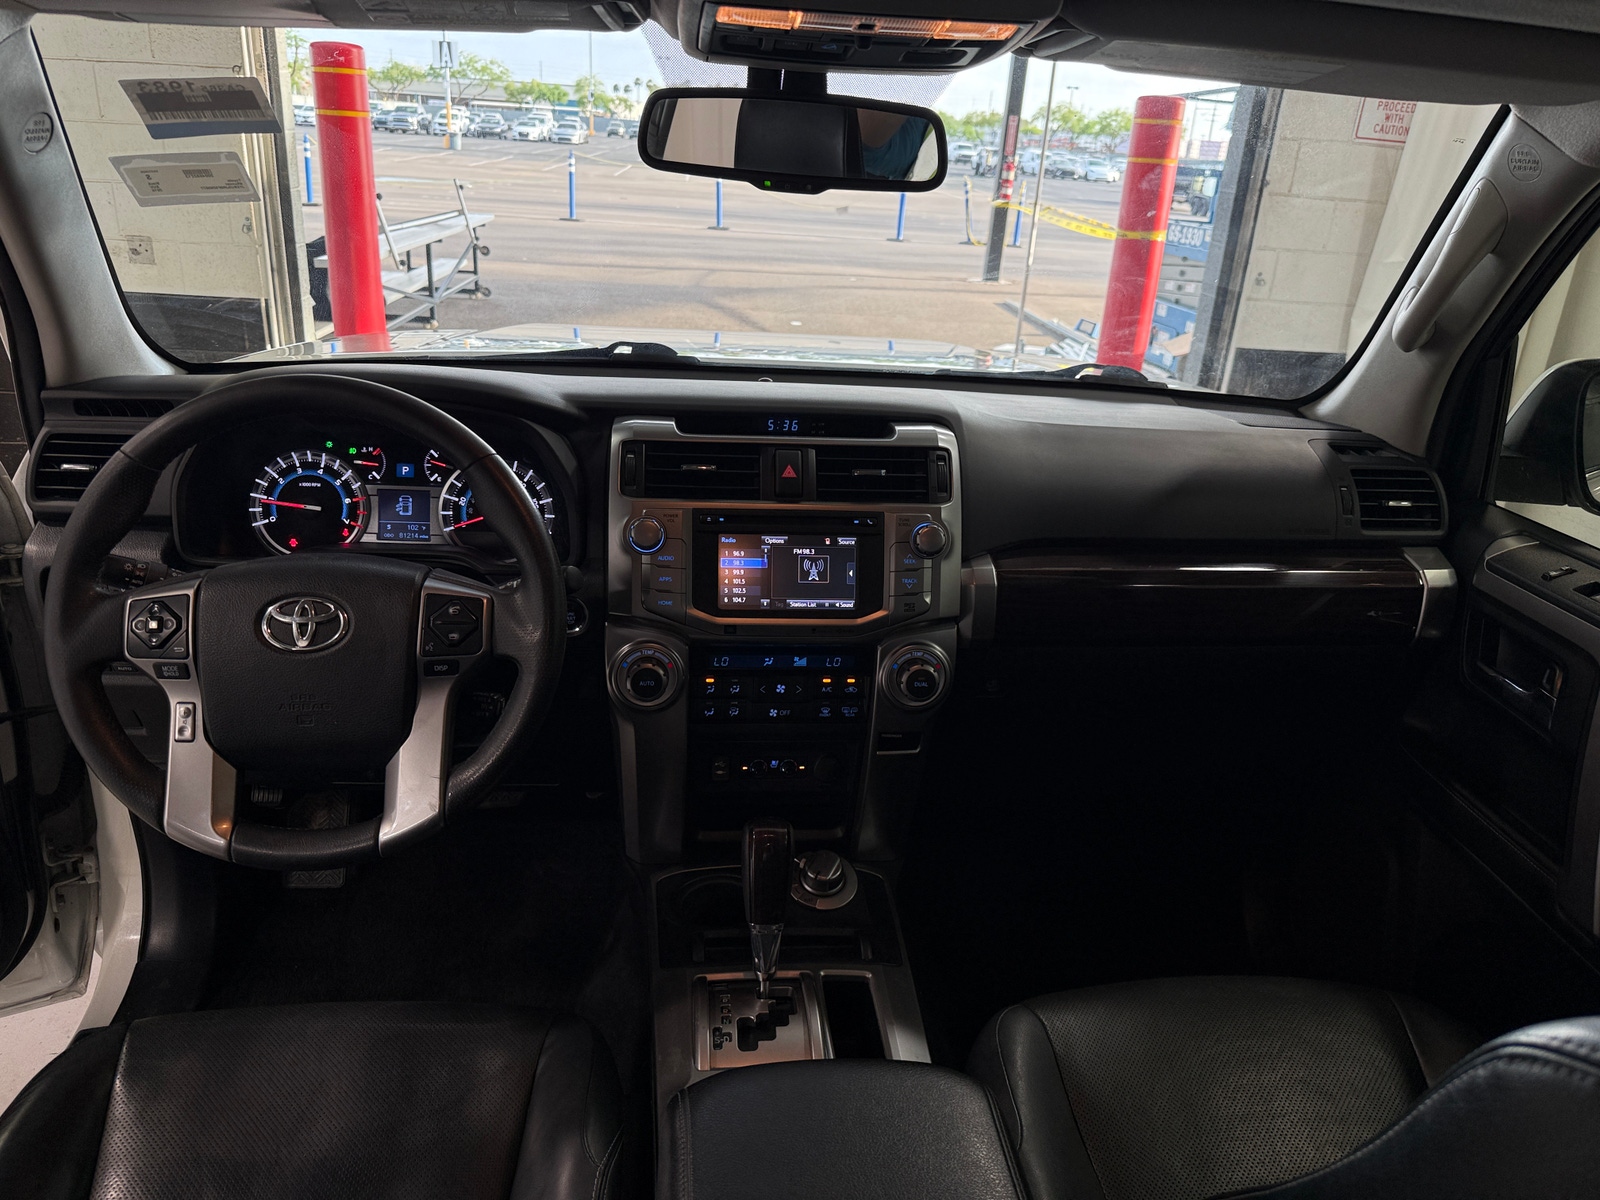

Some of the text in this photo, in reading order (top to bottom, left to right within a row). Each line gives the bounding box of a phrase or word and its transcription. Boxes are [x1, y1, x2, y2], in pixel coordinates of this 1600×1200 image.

[1376, 100, 1417, 114] PROCEED
[1384, 112, 1405, 125] WITH
[1373, 123, 1411, 137] CAUTION
[1167, 223, 1205, 247] GS-1930
[767, 419, 799, 431] 5:36
[296, 467, 303, 475] 3
[402, 465, 410, 476] P
[278, 477, 286, 485] 2
[334, 478, 342, 486] 5
[458, 496, 467, 506] 20
[721, 536, 737, 544] Radio
[764, 537, 786, 546] Options
[838, 538, 857, 546] Source
[713, 656, 730, 667] LO
[825, 657, 842, 668] LO
[433, 664, 449, 672] DISP
[779, 708, 792, 716] OFF
